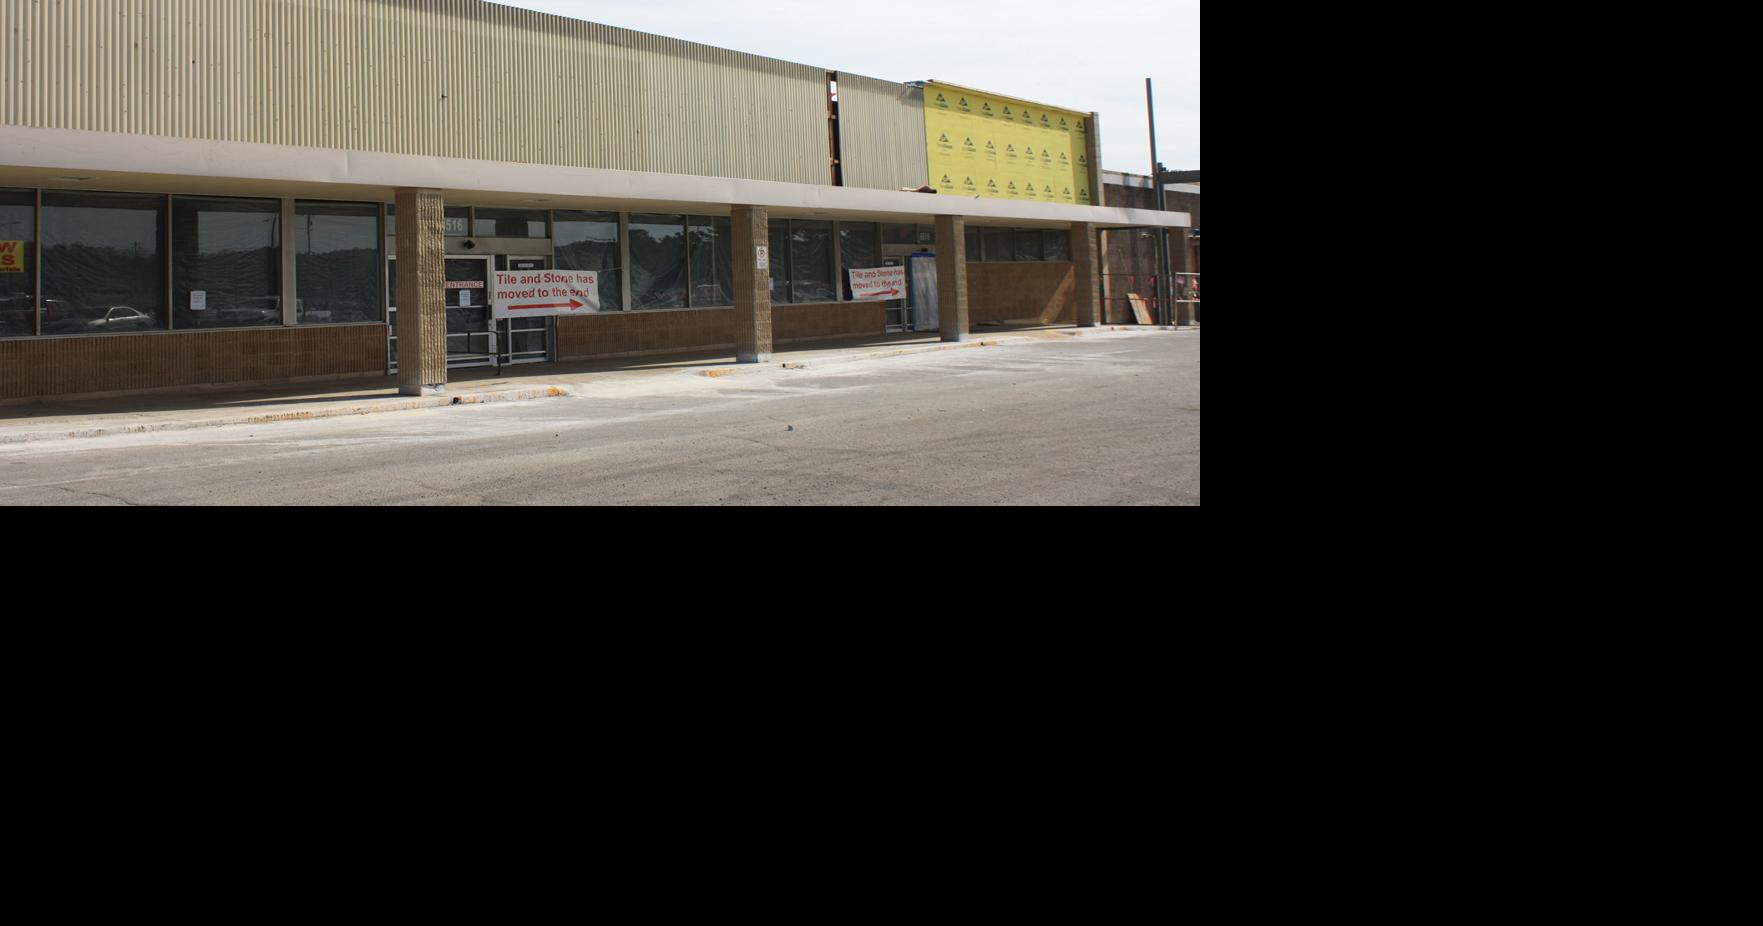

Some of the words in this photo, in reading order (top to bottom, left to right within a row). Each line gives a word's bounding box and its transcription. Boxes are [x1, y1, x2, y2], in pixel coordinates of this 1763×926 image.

[497, 274, 517, 284] Tile
[520, 273, 541, 284] and
[543, 273, 574, 283] Stone
[576, 273, 594, 284] has
[852, 280, 873, 289] moved
[497, 287, 535, 299] moved
[537, 288, 549, 297] to
[552, 287, 567, 297] the
[569, 287, 590, 297] end
